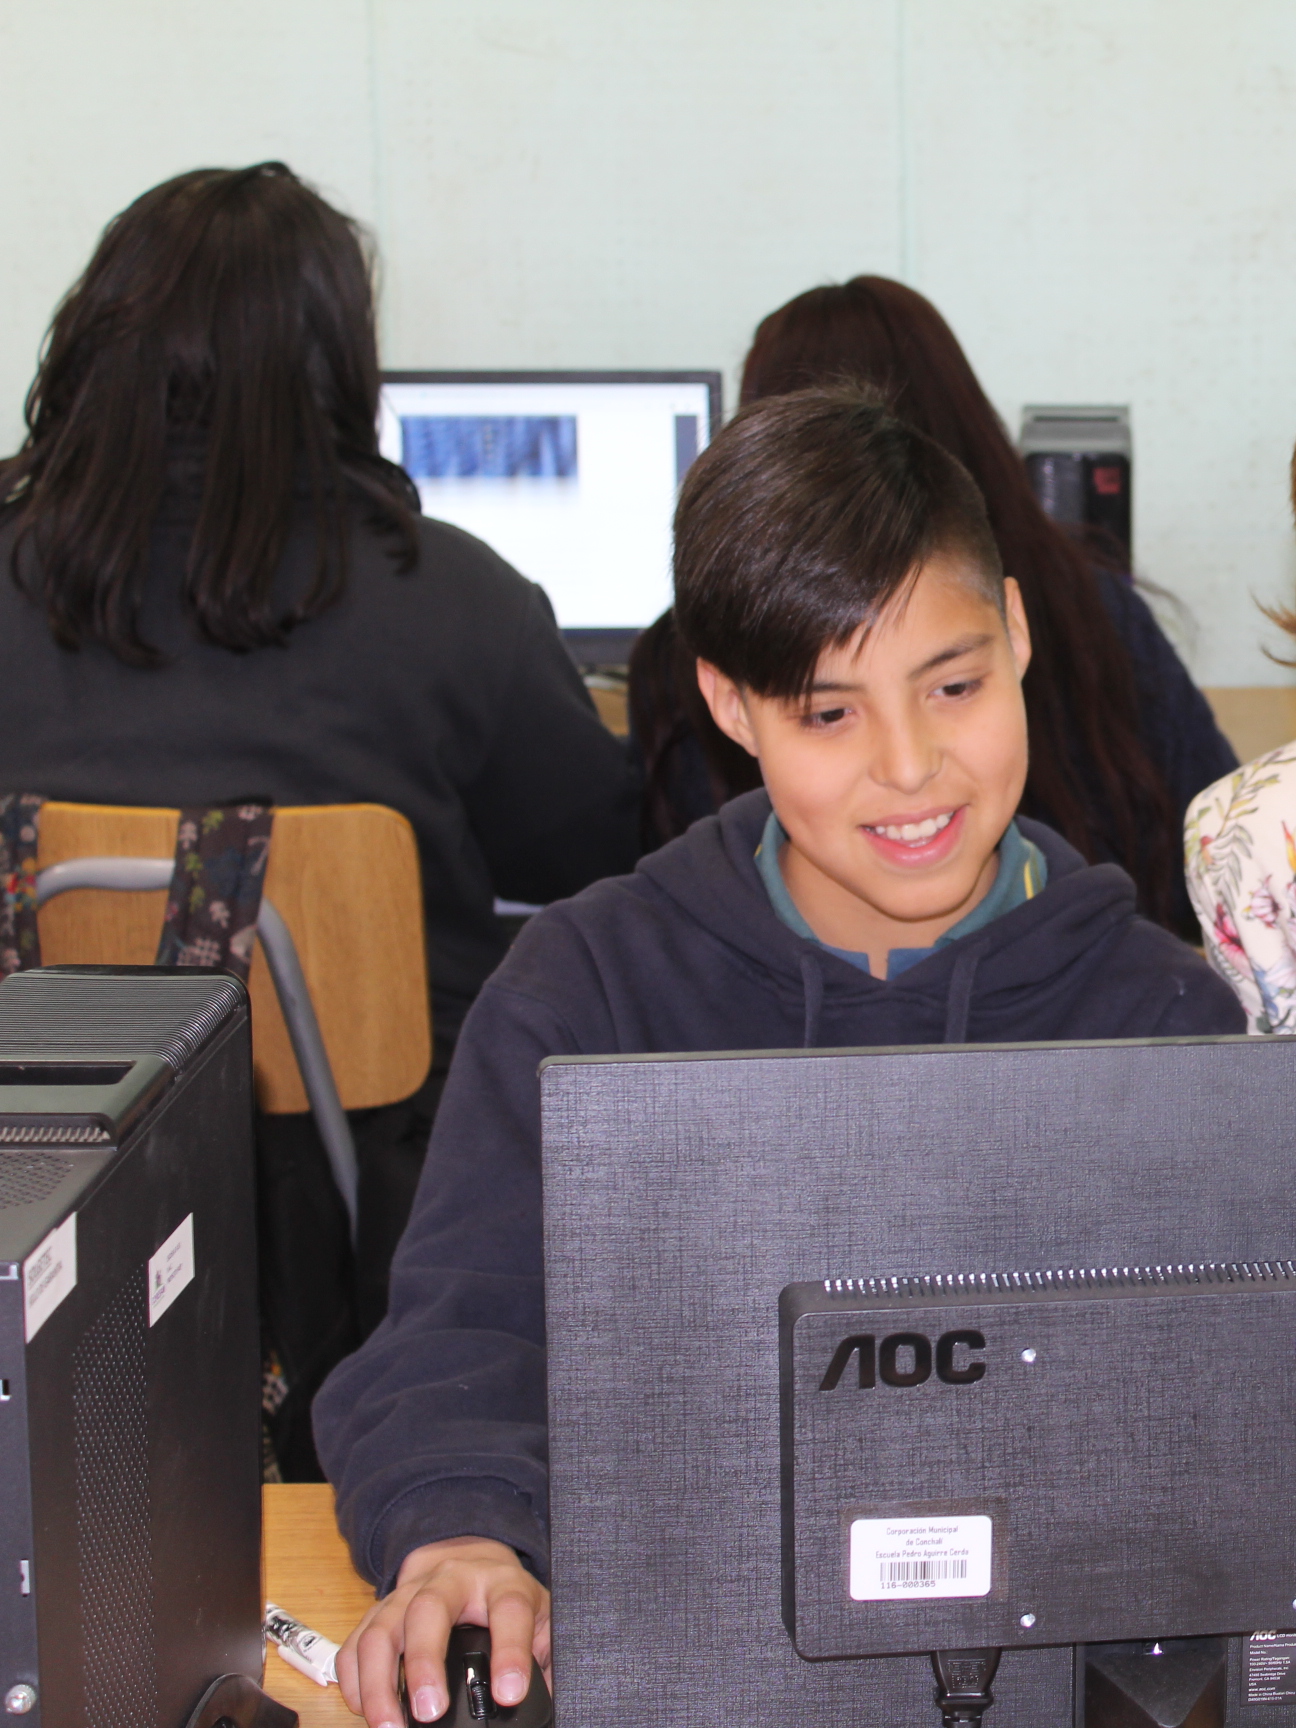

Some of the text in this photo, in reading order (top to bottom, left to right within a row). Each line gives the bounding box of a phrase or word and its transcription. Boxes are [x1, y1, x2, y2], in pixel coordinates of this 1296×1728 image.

[818, 1329, 986, 1391] AOC
[887, 1526, 959, 1536] Corporación Municipal
[916, 1538, 943, 1546] Conchalí
[876, 1551, 901, 1559] Escuela
[903, 1550, 922, 1558] Pedro
[924, 1549, 948, 1558] Aguirre
[882, 1581, 936, 1589] 116-000365
[1250, 1630, 1277, 1641] AOC
